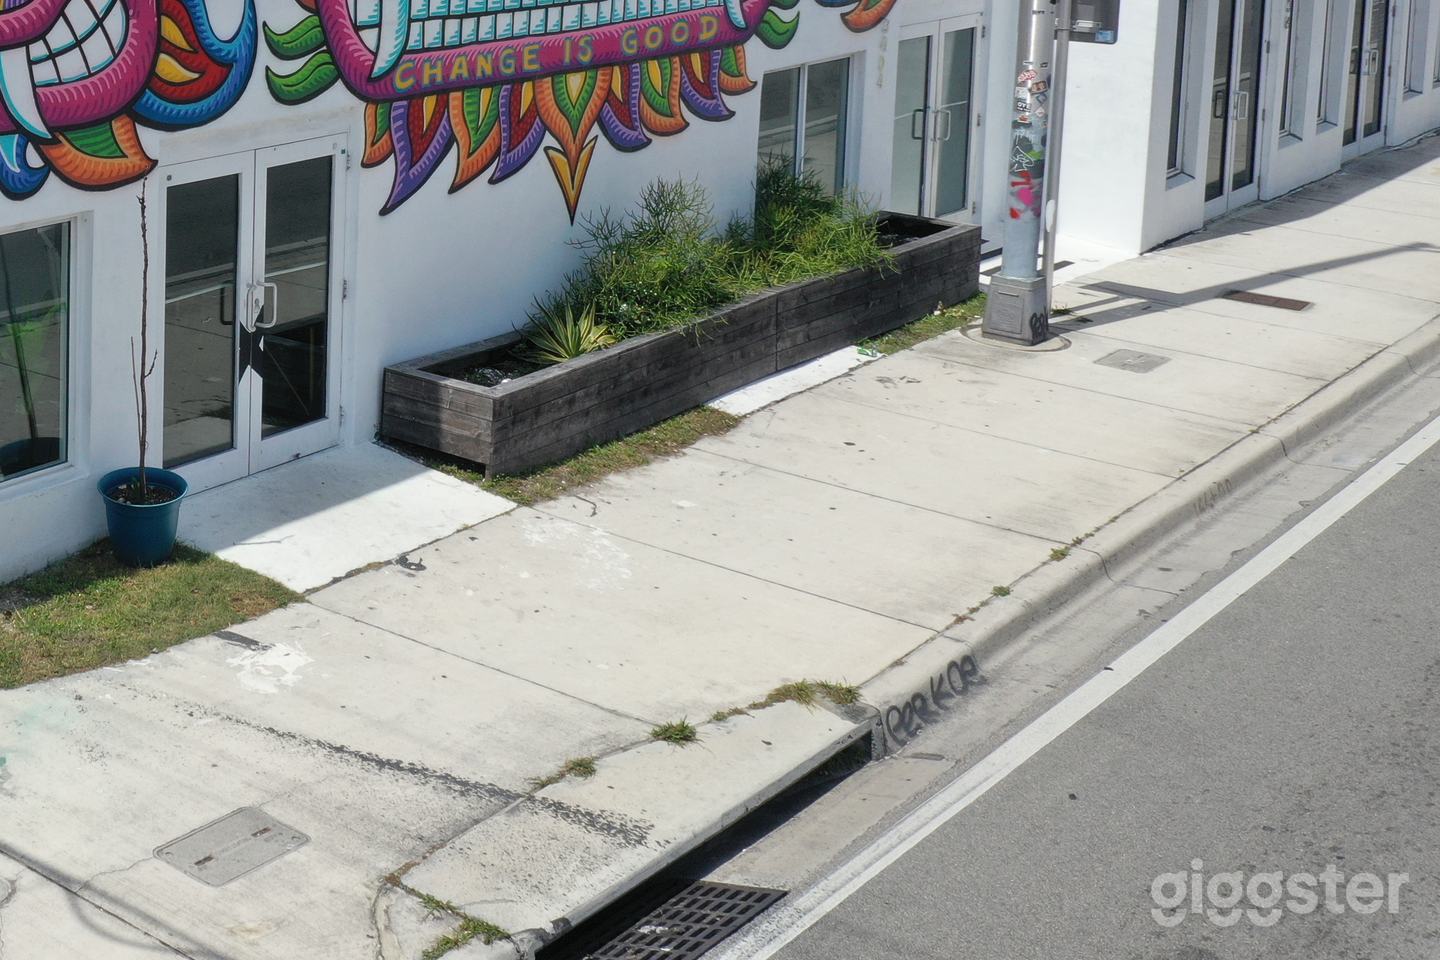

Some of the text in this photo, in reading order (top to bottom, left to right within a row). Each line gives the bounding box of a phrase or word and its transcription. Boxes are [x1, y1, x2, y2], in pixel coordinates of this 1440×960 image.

[392, 14, 719, 93] CHANGE IS GOOD
